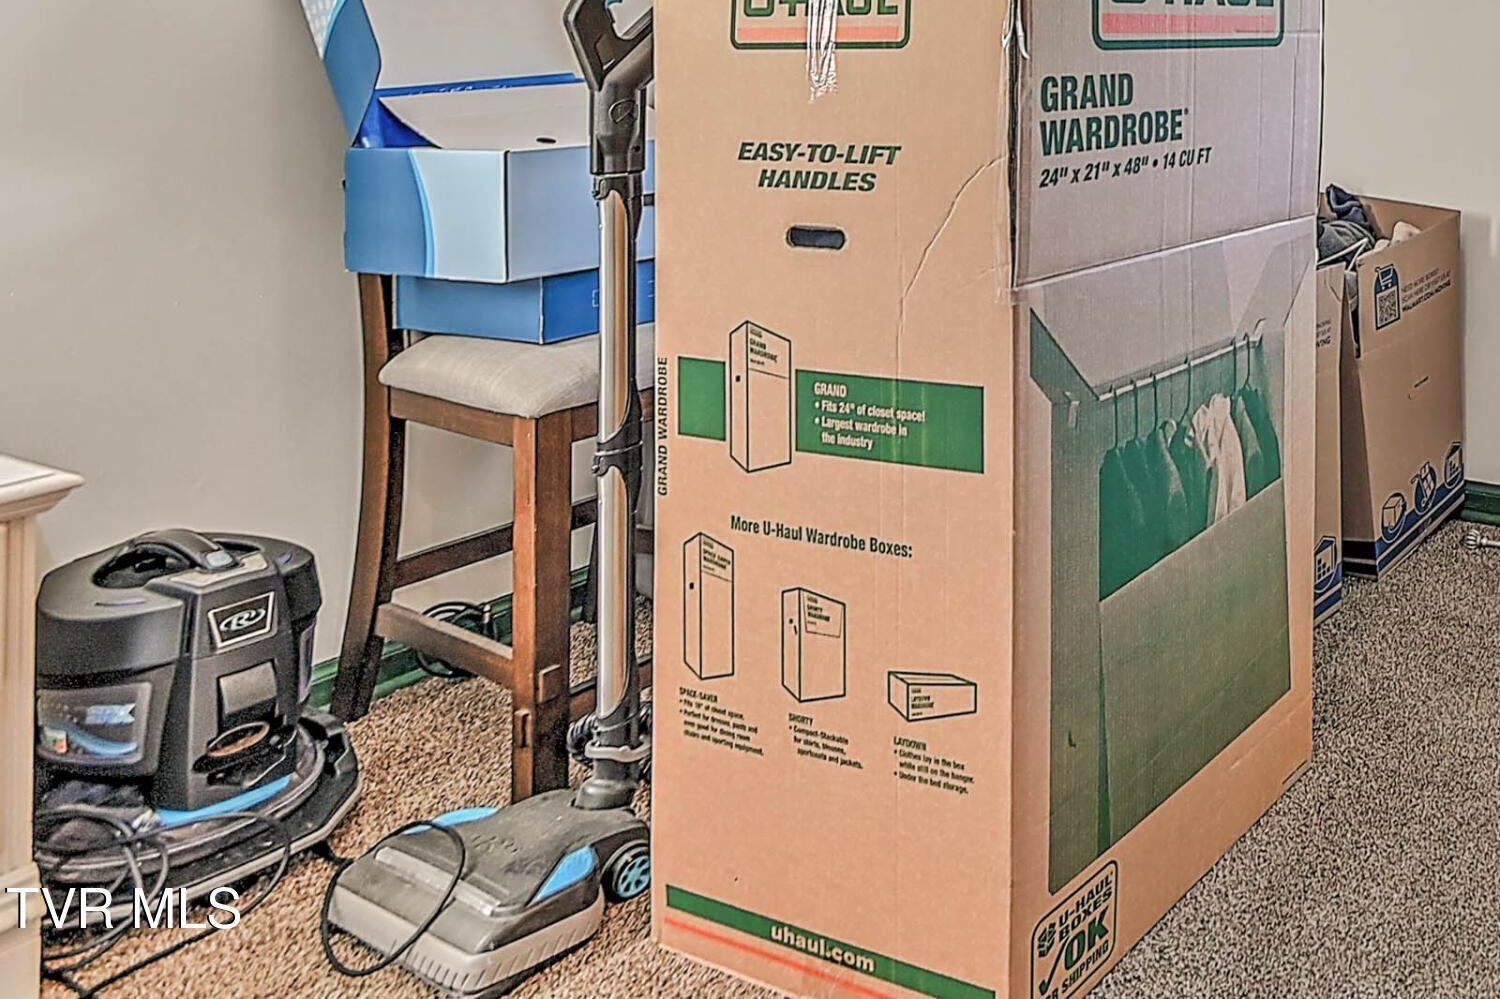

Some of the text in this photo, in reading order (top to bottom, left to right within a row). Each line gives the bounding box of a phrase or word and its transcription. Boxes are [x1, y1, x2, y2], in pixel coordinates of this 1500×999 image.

[1040, 73, 1133, 112] GRAND
[738, 142, 902, 165] EASY-TO-LIFT
[1039, 109, 1184, 156] WARDROBE
[758, 169, 877, 192] HANDLES
[1039, 167, 1068, 189] 24"
[1083, 161, 1110, 182] 21"
[1124, 155, 1149, 175] 48"
[1163, 152, 1176, 169] 14
[1179, 149, 1195, 167] CU
[1197, 147, 1212, 164] FT
[814, 382, 847, 398] GRAND
[821, 400, 837, 413] Fits
[857, 404, 866, 415] of
[867, 406, 894, 418] closet
[657, 356, 668, 496] GRAND WARDROBE
[821, 416, 907, 436] Largest wardrobe in
[821, 432, 873, 451] the industry
[730, 515, 913, 558] More U-Haul Wardrobe Boxes:
[1059, 873, 1113, 926] U-HAUL
[1059, 886, 1113, 942] BOXES
[770, 925, 875, 973] uhaul.com
[1064, 904, 1110, 971] OK
[1061, 939, 1110, 994] SHIPPING
